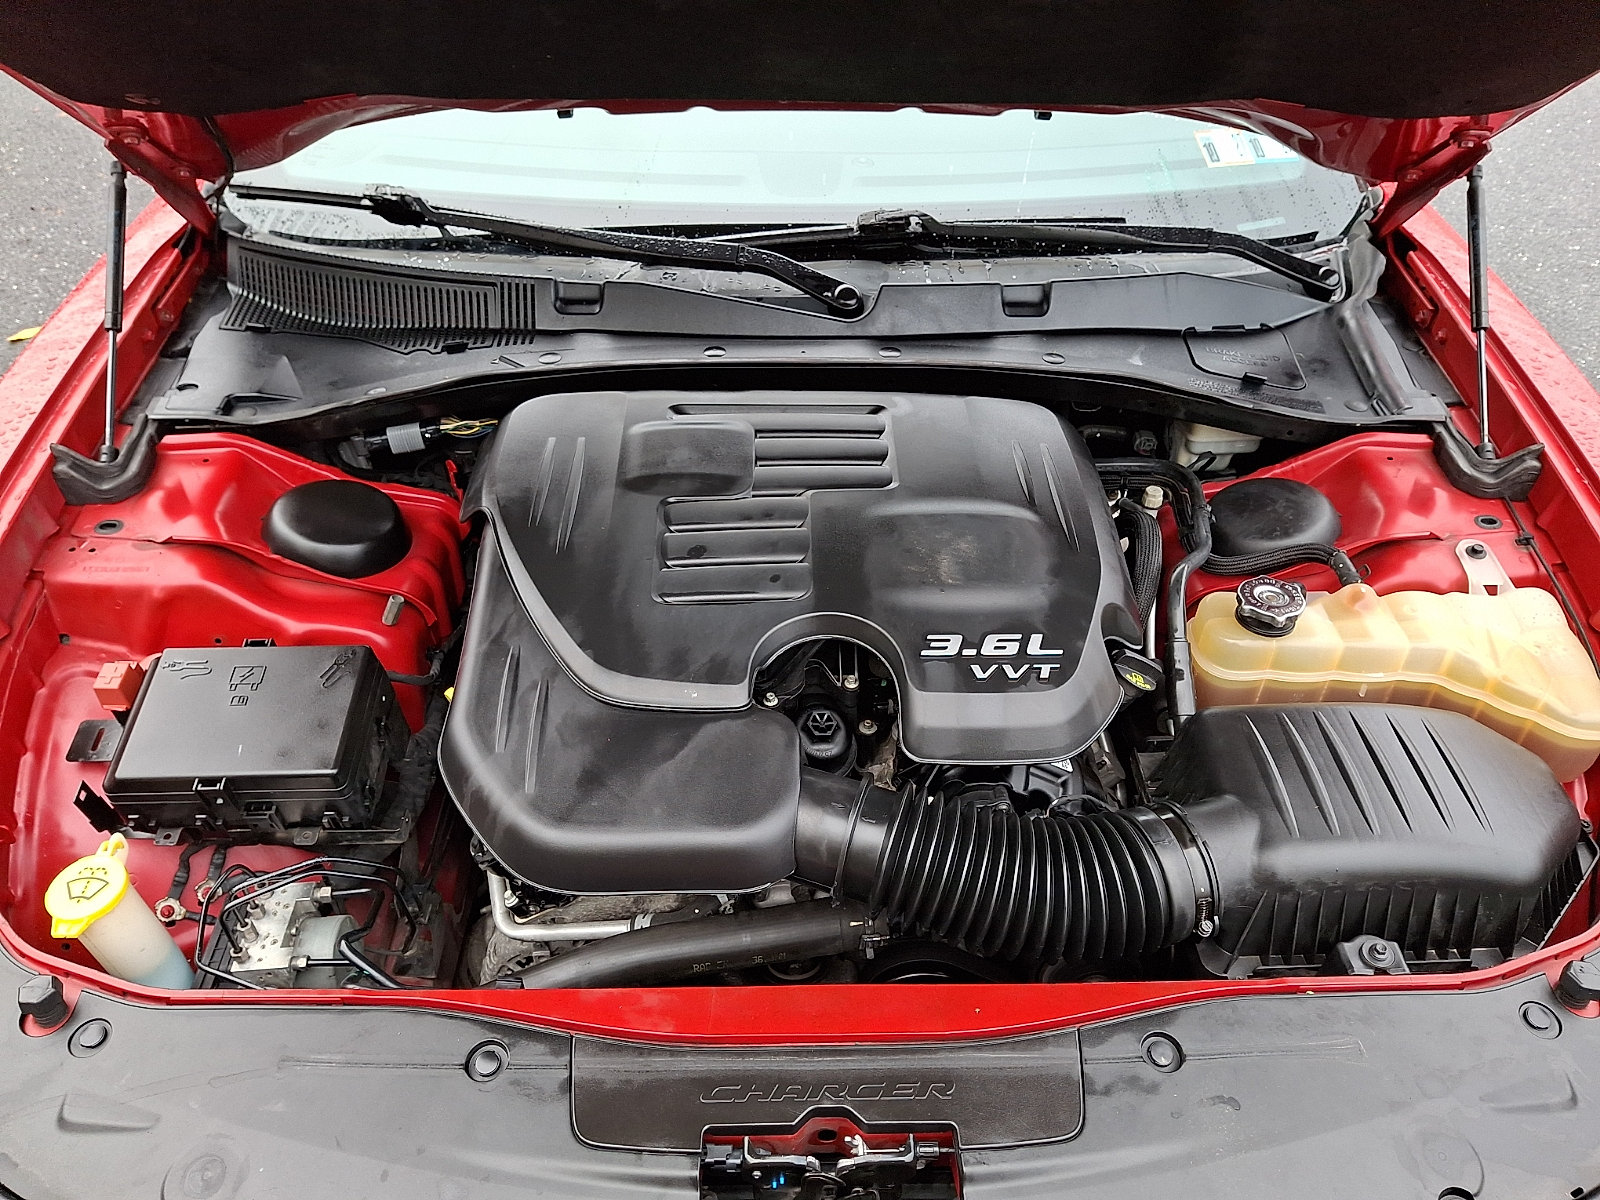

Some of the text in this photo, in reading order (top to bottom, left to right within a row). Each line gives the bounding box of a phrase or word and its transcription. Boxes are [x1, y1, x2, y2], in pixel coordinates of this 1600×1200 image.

[920, 633, 1064, 658] 3.6L
[969, 664, 1061, 682] VVT
[700, 1081, 956, 1103] CHARGER
